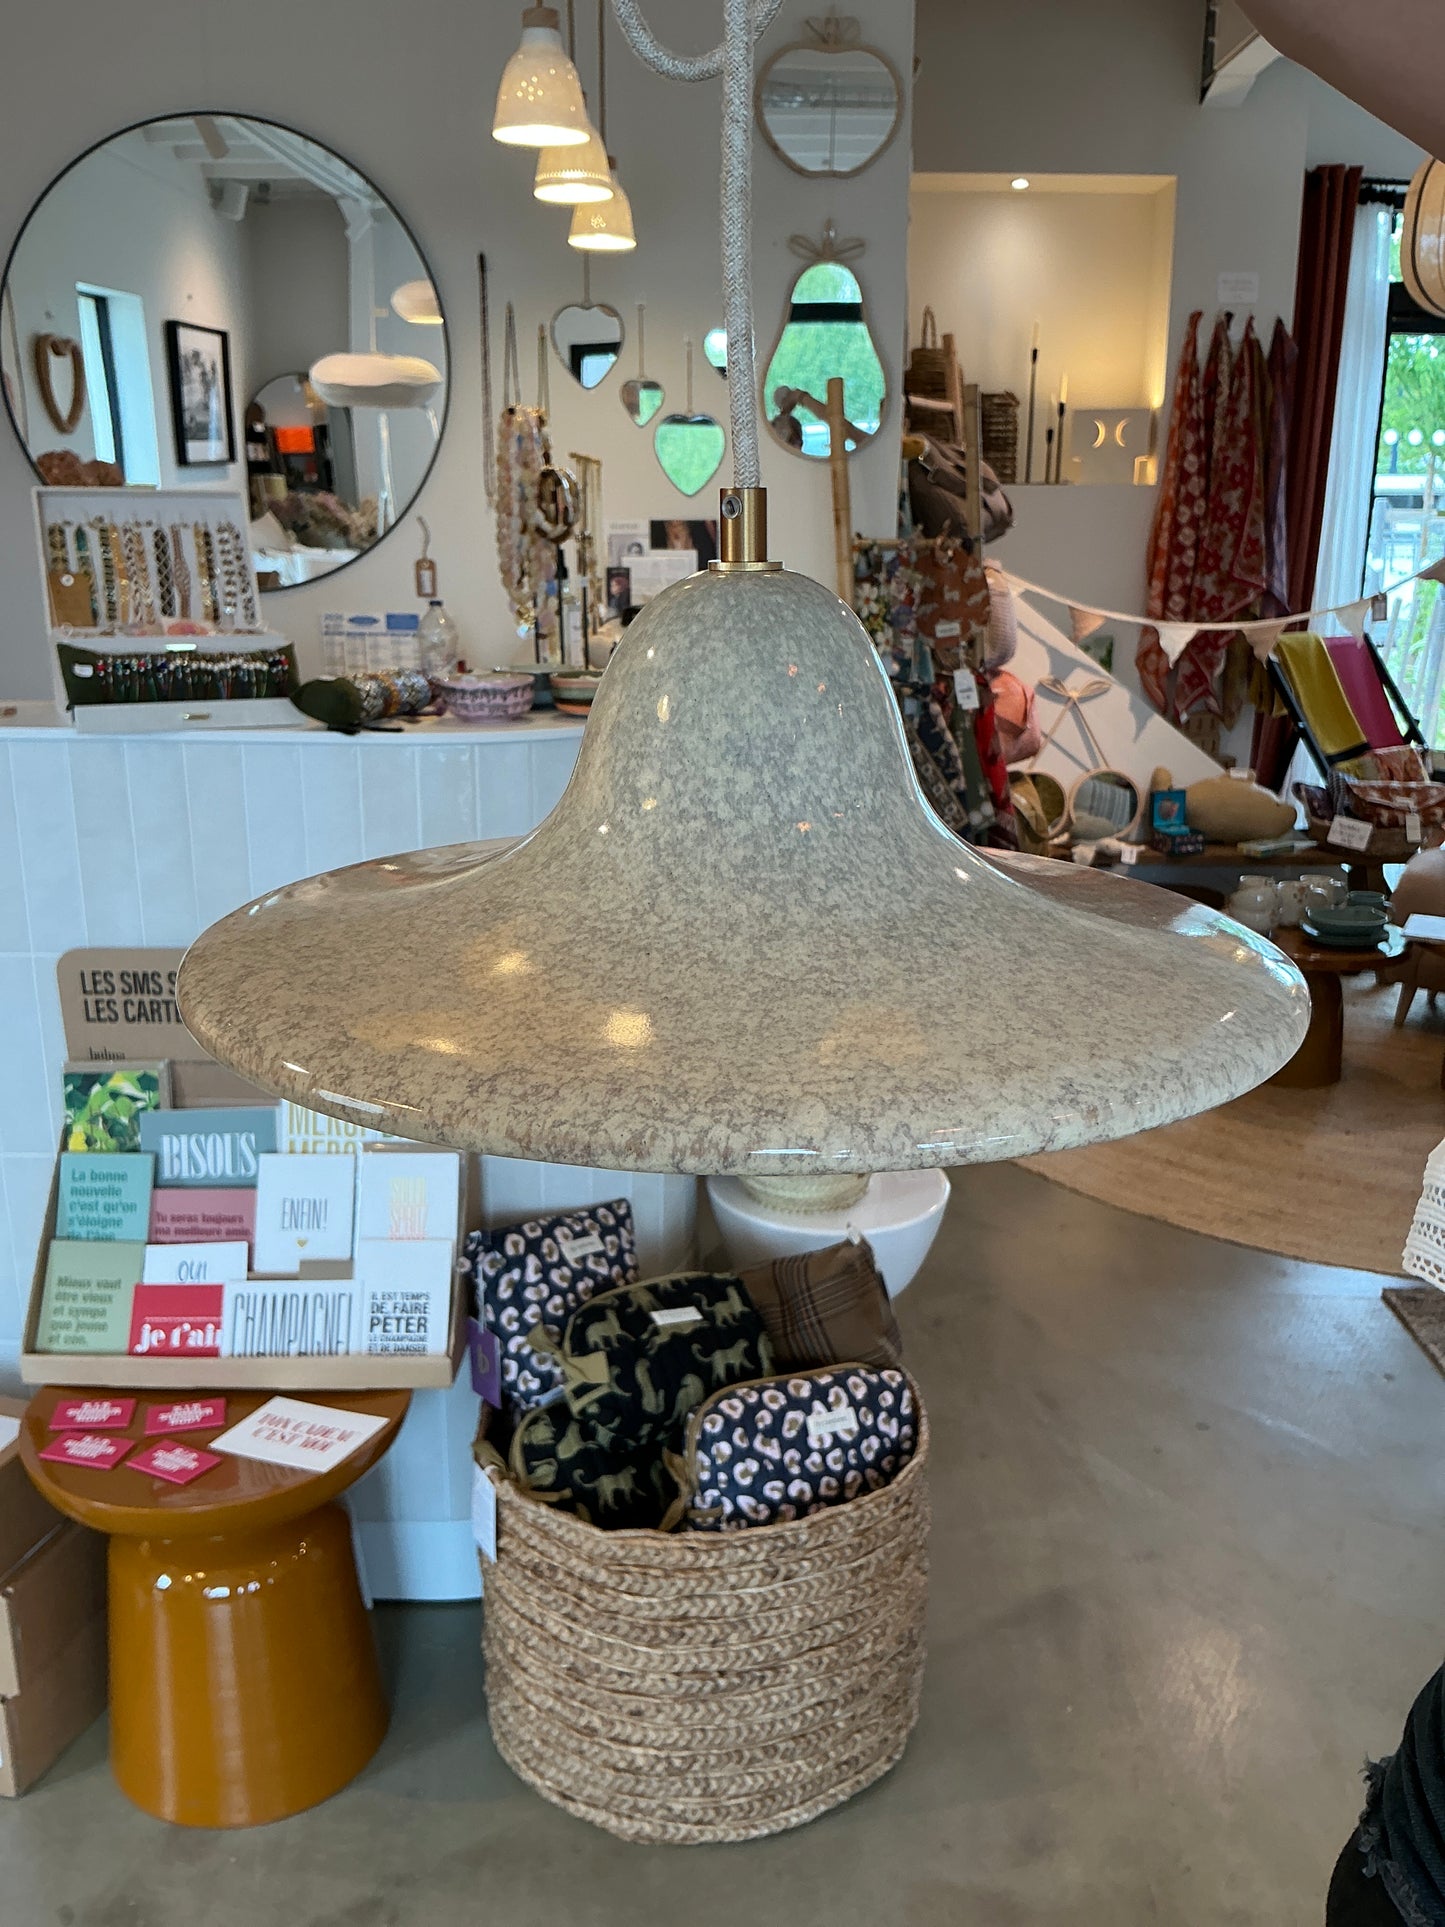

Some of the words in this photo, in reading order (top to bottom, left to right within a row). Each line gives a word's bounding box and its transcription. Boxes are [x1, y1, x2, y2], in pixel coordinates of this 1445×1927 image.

[80, 969, 116, 996] LES
[119, 969, 163, 996] SMS
[84, 998, 119, 1024] LES
[287, 1101, 366, 1138] MERC
[160, 1131, 257, 1180] BISOUS
[71, 1167, 86, 1182] La
[90, 1168, 129, 1182] bonne
[70, 1184, 122, 1198] nouvelle
[103, 1201, 137, 1215] qu'on
[281, 1197, 328, 1231] ENFIN!
[202, 1212, 244, 1224] toujours
[174, 1225, 222, 1237] meilleure
[178, 1259, 208, 1283] OUI
[382, 1291, 398, 1301] EST
[400, 1291, 430, 1301] TEMPS
[371, 1302, 388, 1314] DE
[393, 1302, 430, 1315] FAIRE
[369, 1315, 428, 1333] PETER
[134, 1322, 166, 1355] je
